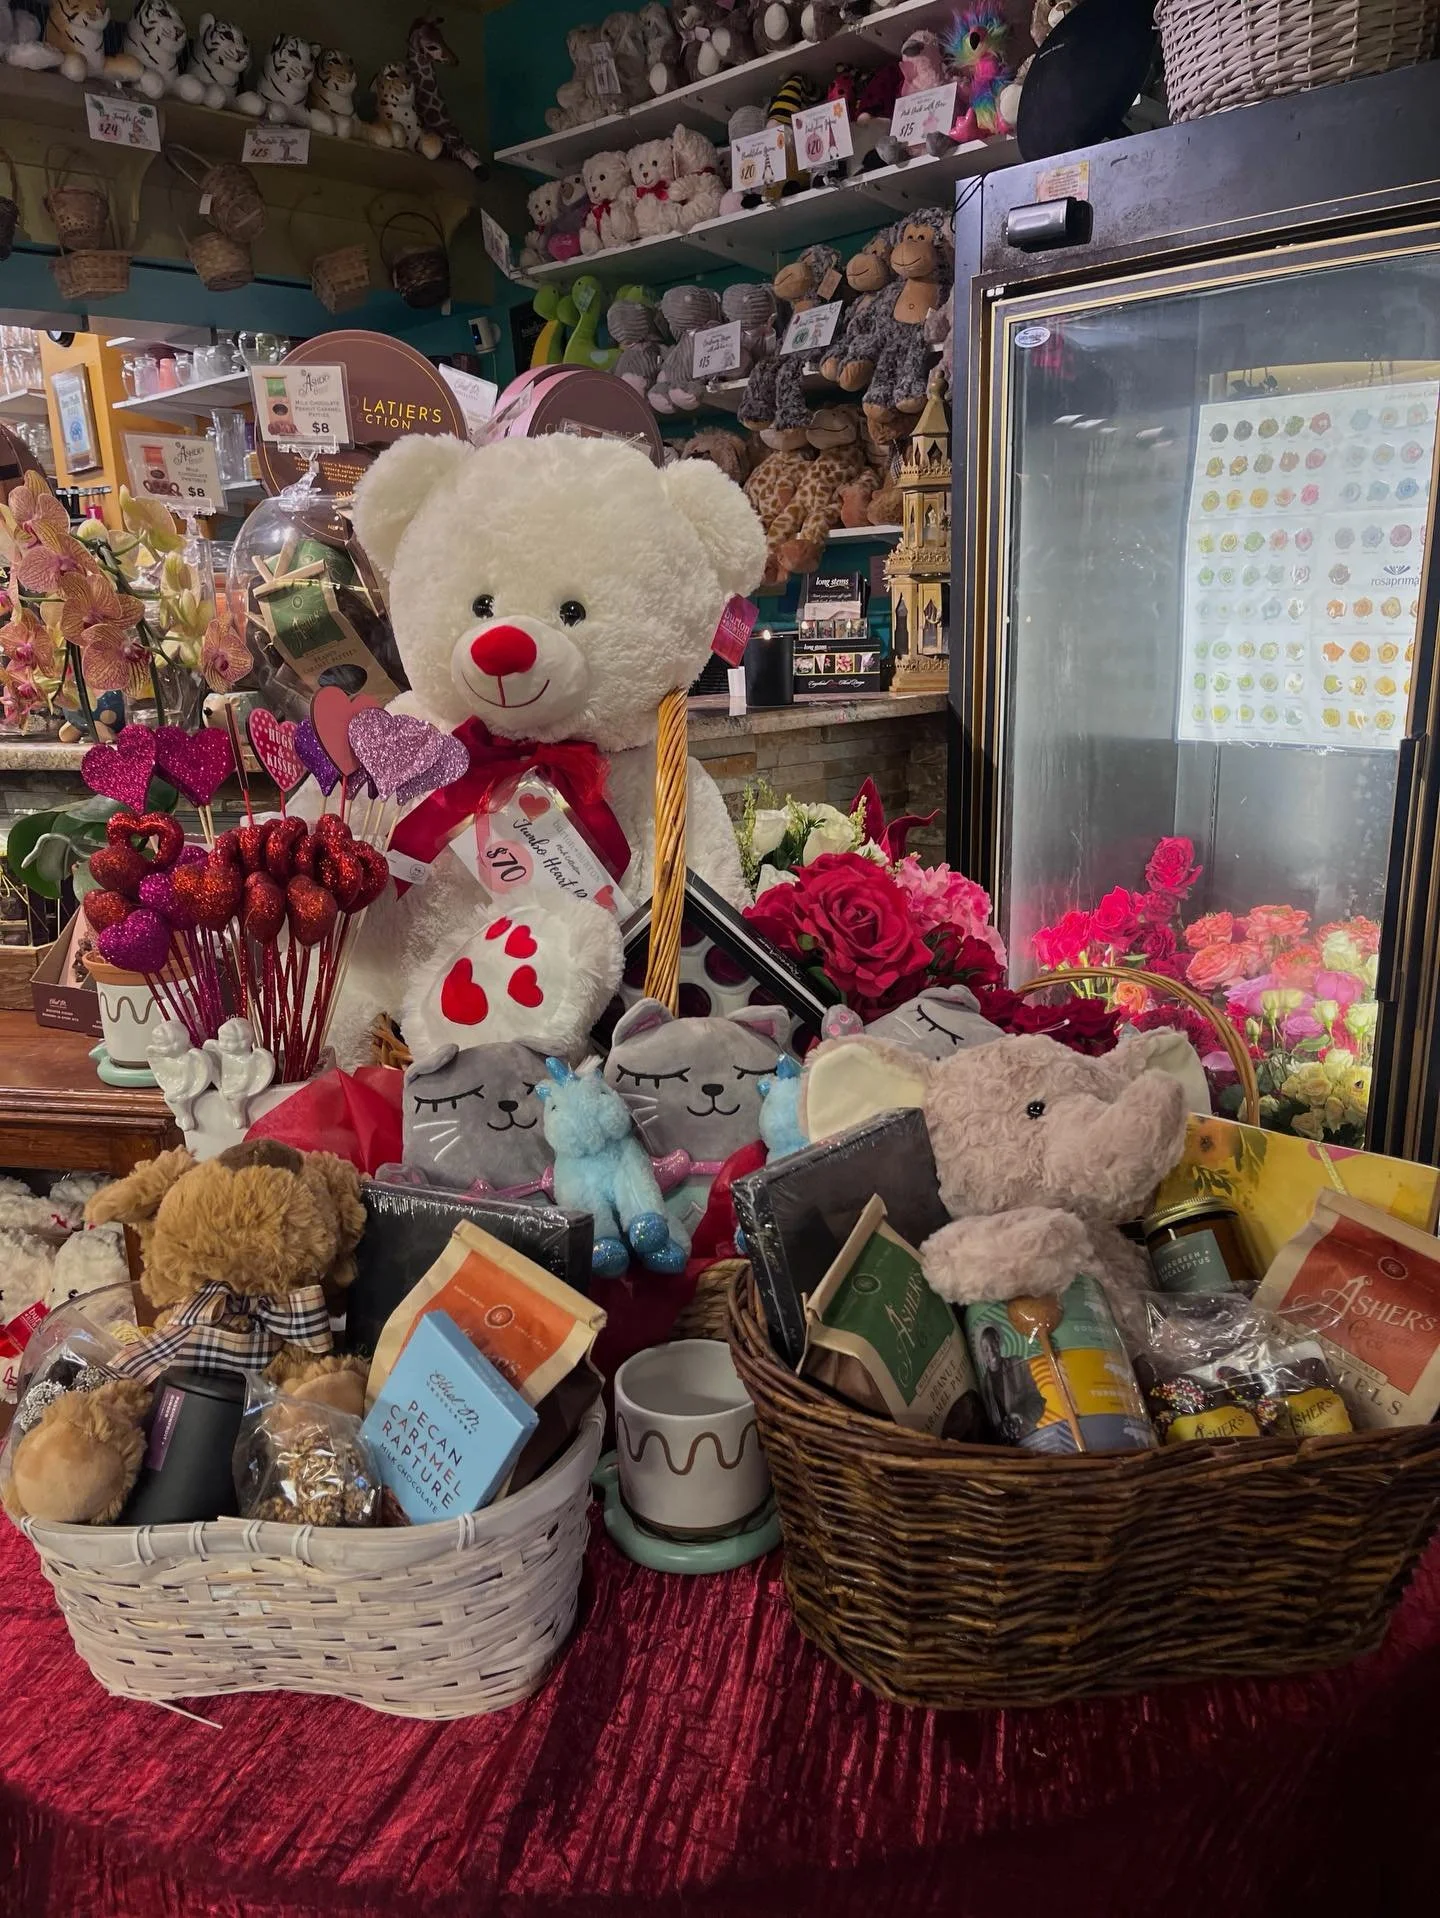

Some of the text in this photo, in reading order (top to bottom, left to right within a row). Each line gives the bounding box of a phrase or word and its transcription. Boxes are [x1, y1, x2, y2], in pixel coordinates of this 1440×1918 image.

[98, 123, 119, 137] $24
[899, 121, 916, 138] $15
[807, 139, 822, 155] $20
[740, 163, 757, 180] $20
[698, 355, 712, 369] $15
[312, 421, 330, 434] $8
[365, 413, 411, 430] CTION
[188, 486, 206, 498] $8
[815, 577, 849, 588] long stems
[724, 607, 751, 635] burton
[268, 728, 293, 751] HUGS
[278, 745, 284, 759] &
[266, 752, 298, 778] KISSES
[485, 846, 527, 883] $70
[513, 818, 550, 856] Jumbo
[543, 856, 578, 890] Heart
[929, 1359, 957, 1400] PEANUT
[922, 1401, 951, 1434] ARAMEL
[1294, 1398, 1334, 1429] SHER'S
[407, 1400, 463, 1468] PECAN
[390, 1404, 463, 1497] CARAMEL
[382, 1420, 454, 1510] RAPTURE
[379, 1443, 440, 1514] MILK CHOCOLATE
